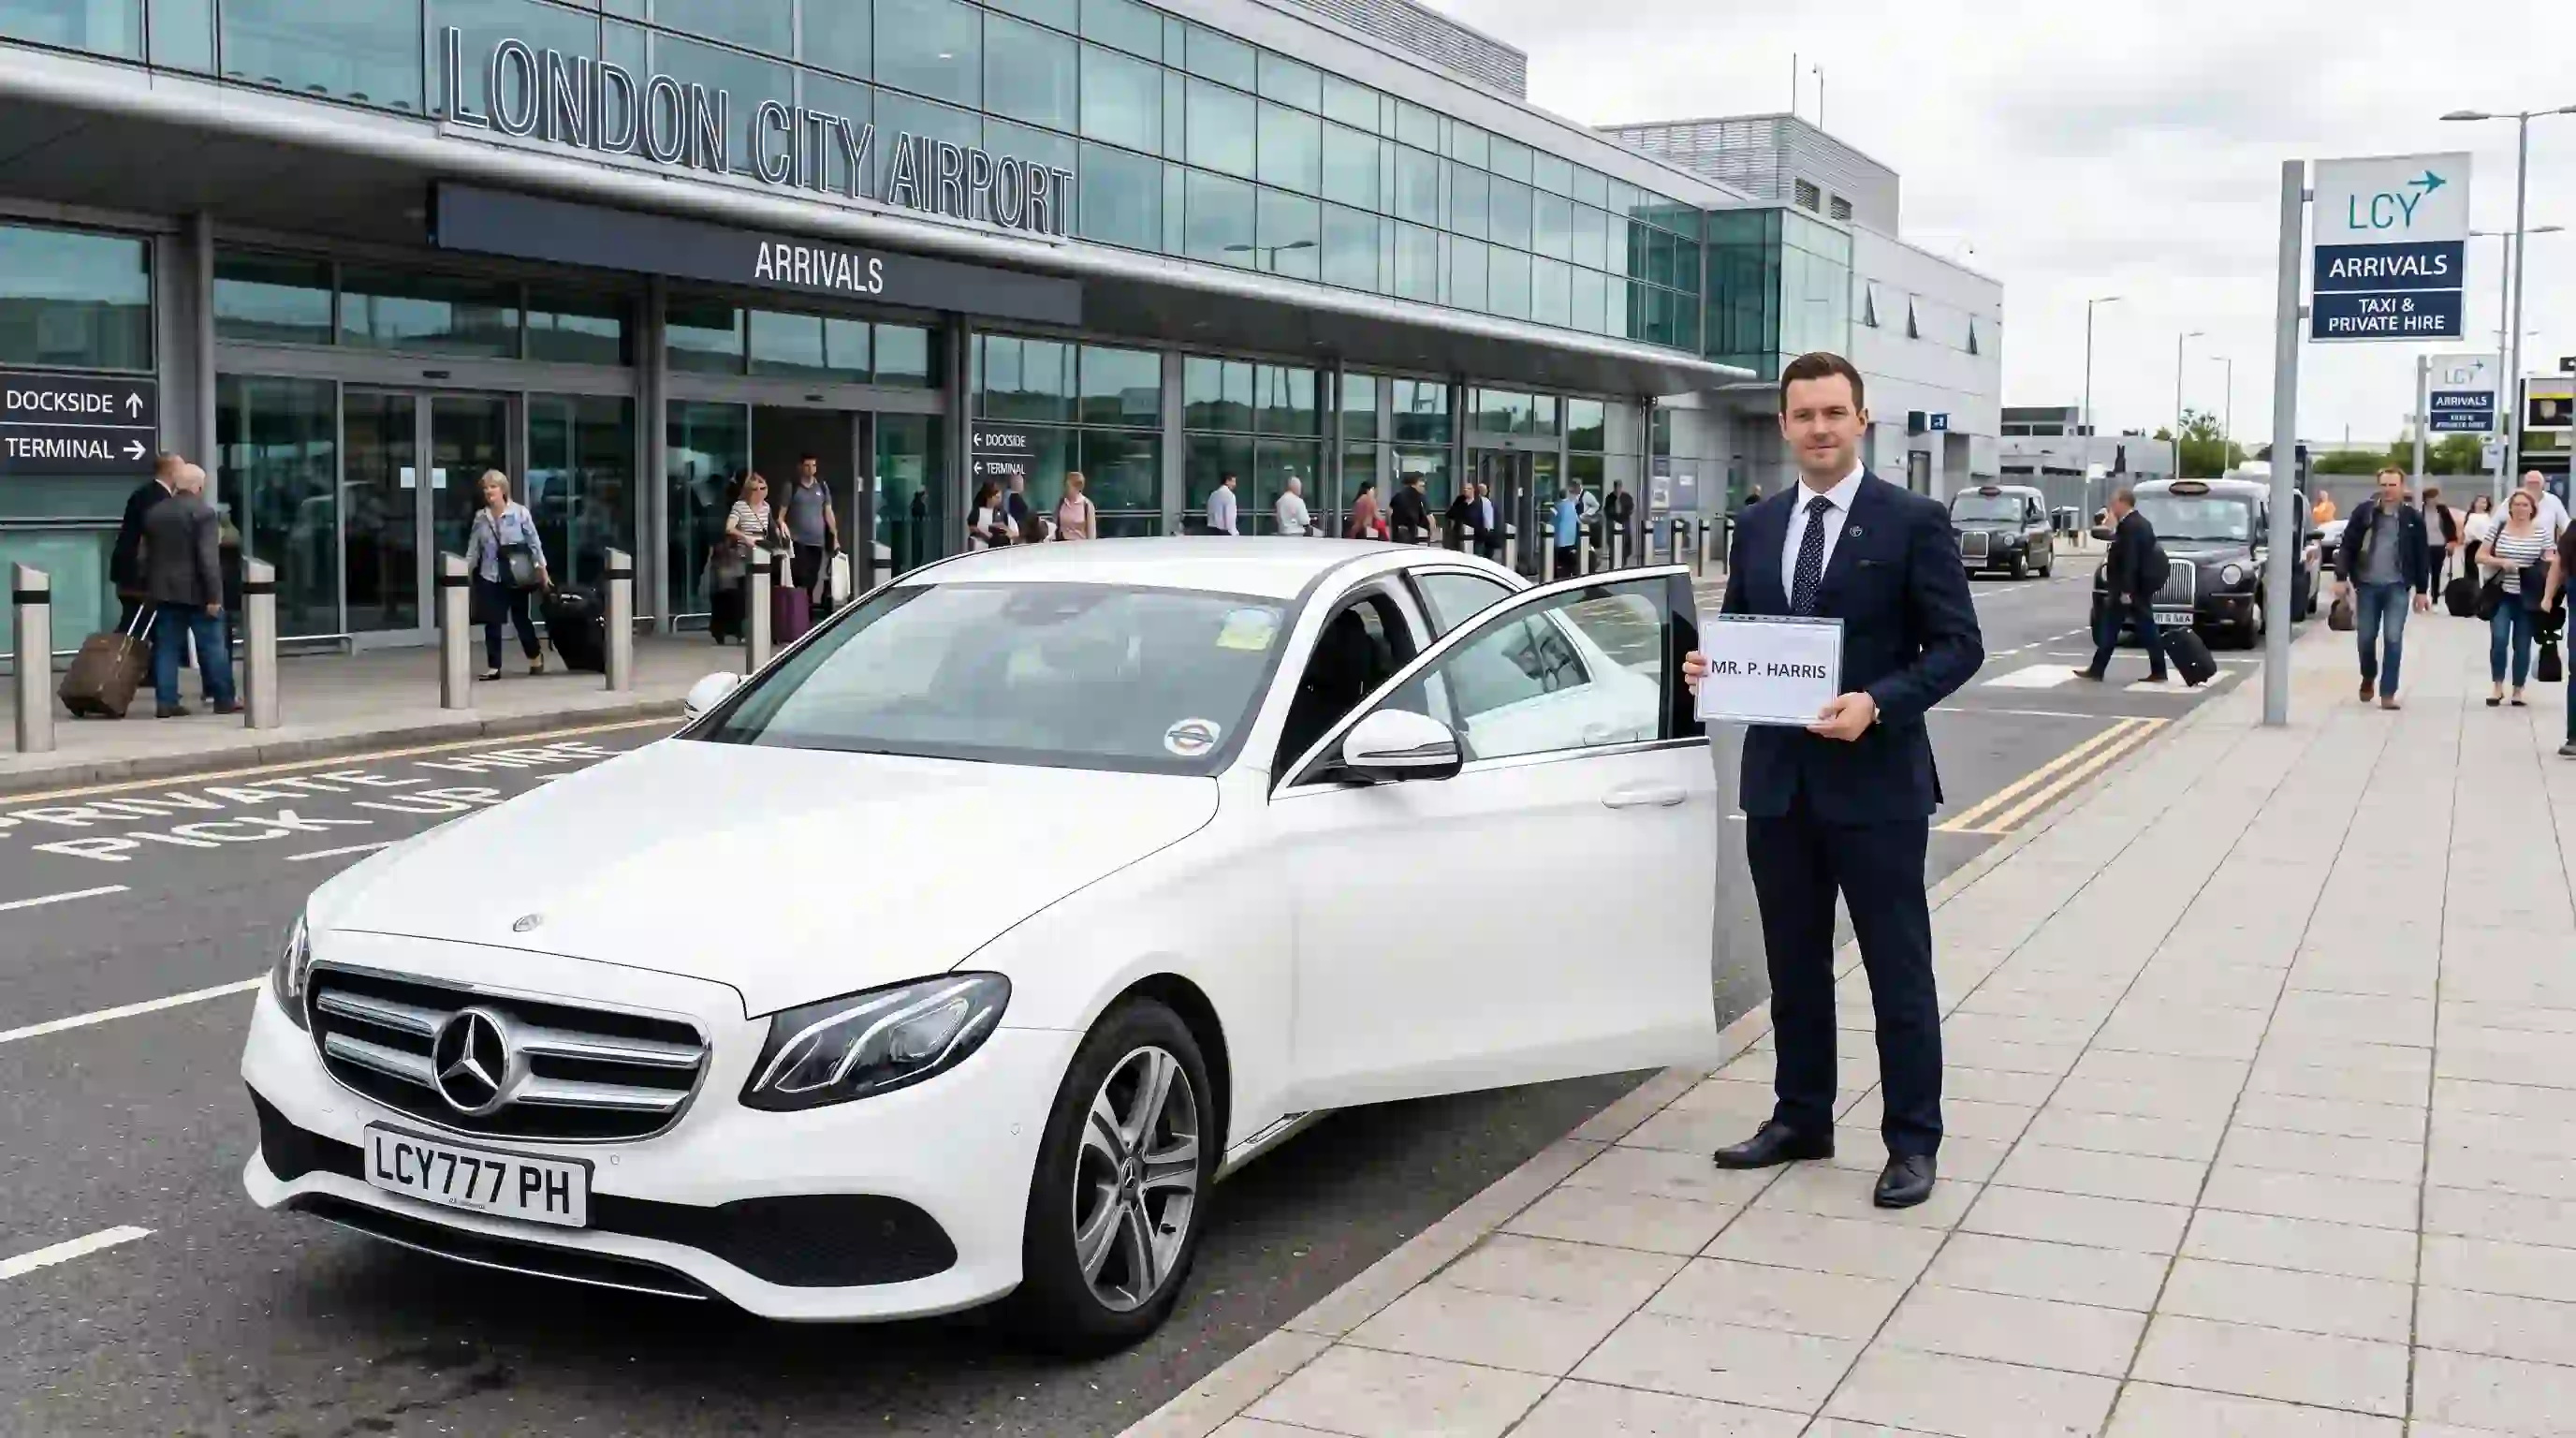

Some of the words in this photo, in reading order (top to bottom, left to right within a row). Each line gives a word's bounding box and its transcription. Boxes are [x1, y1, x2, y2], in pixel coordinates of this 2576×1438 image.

[440, 25, 729, 174] LONDON
[751, 99, 874, 199] CITY
[888, 131, 1075, 237] AIRPORT
[2349, 192, 2422, 229] LCY
[754, 241, 884, 294] ARRIVALS
[2329, 254, 2448, 278] ARRIVALS
[2359, 298, 2396, 314] TAXI
[2402, 298, 2415, 313] &
[2329, 315, 2398, 331] PRIVATE
[2404, 315, 2445, 330] HIRE
[7, 389, 114, 414] DOCKSIDE
[2436, 396, 2487, 407] ARRIVALS
[5, 437, 115, 460] TERMINAL
[986, 462, 1027, 475] TERMINAL
[1711, 659, 1742, 675] MR.
[1748, 662, 1762, 676] P.
[1767, 663, 1826, 679] HARRIS
[31, 809, 373, 861] PICK
[352, 786, 505, 814] UP
[375, 1137, 506, 1203] LCY777
[520, 1165, 570, 1214] PH
